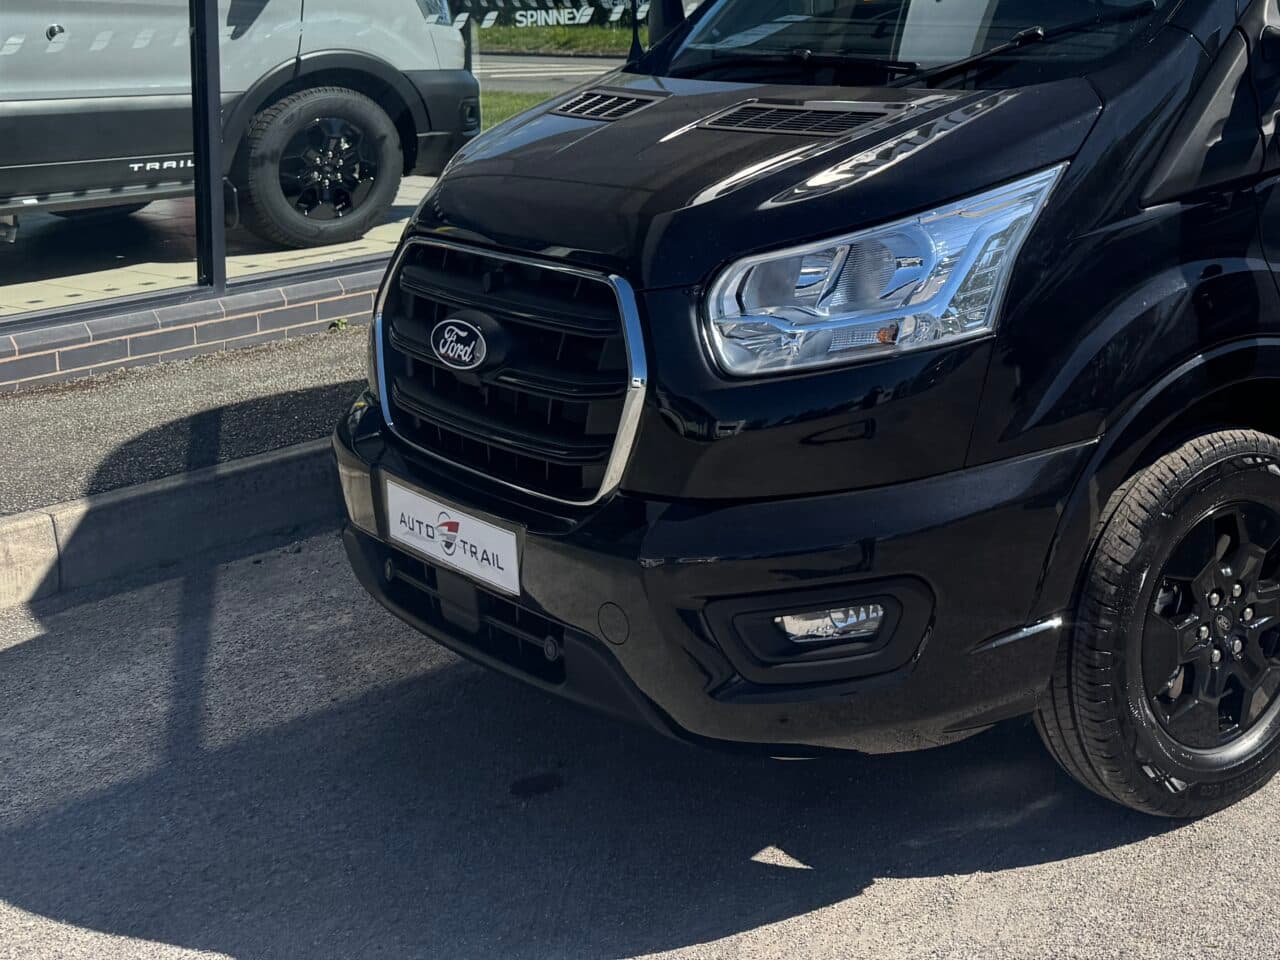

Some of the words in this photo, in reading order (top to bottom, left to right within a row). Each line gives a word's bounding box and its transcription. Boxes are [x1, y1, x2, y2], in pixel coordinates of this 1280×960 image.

[515, 5, 590, 28] SPINNEY
[128, 159, 195, 172] TRAIL
[439, 325, 476, 363] Ford
[400, 512, 435, 540] AUTO
[460, 540, 504, 571] TRAIL
